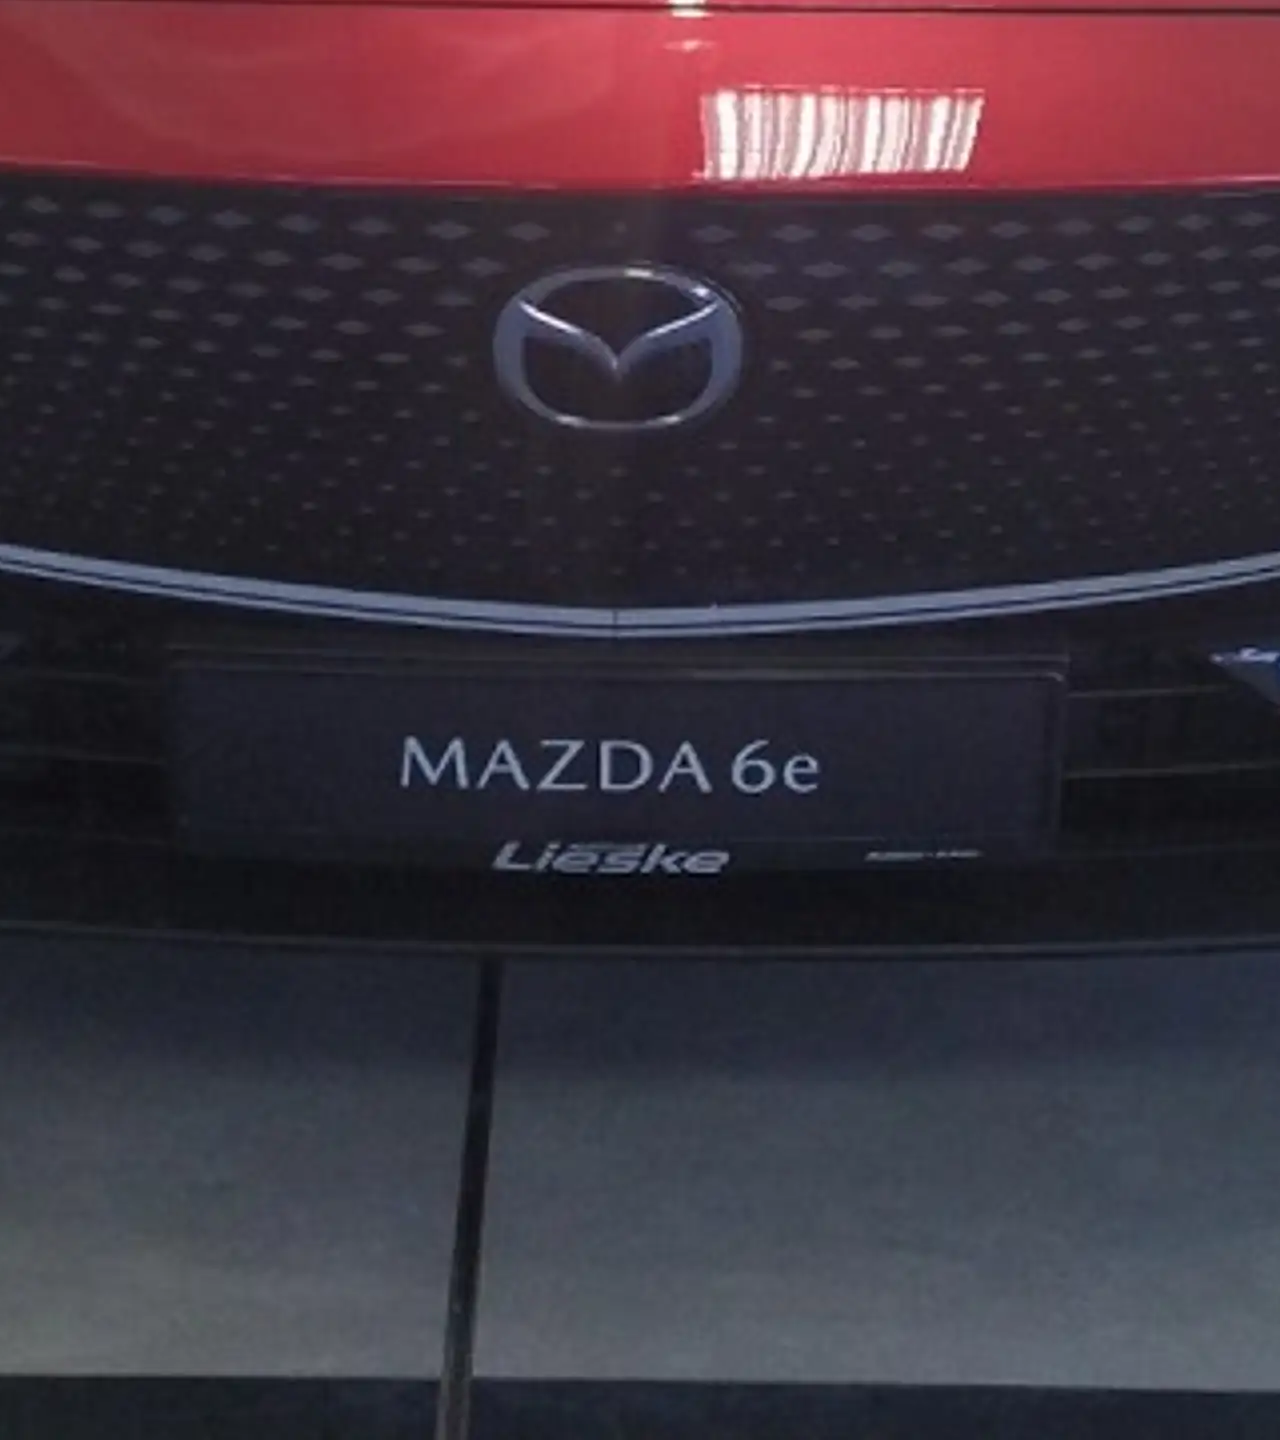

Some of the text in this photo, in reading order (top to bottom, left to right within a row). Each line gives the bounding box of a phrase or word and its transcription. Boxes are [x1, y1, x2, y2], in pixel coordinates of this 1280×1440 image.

[400, 735, 820, 794] MAZDA 6e
[493, 840, 731, 875] Lieske
